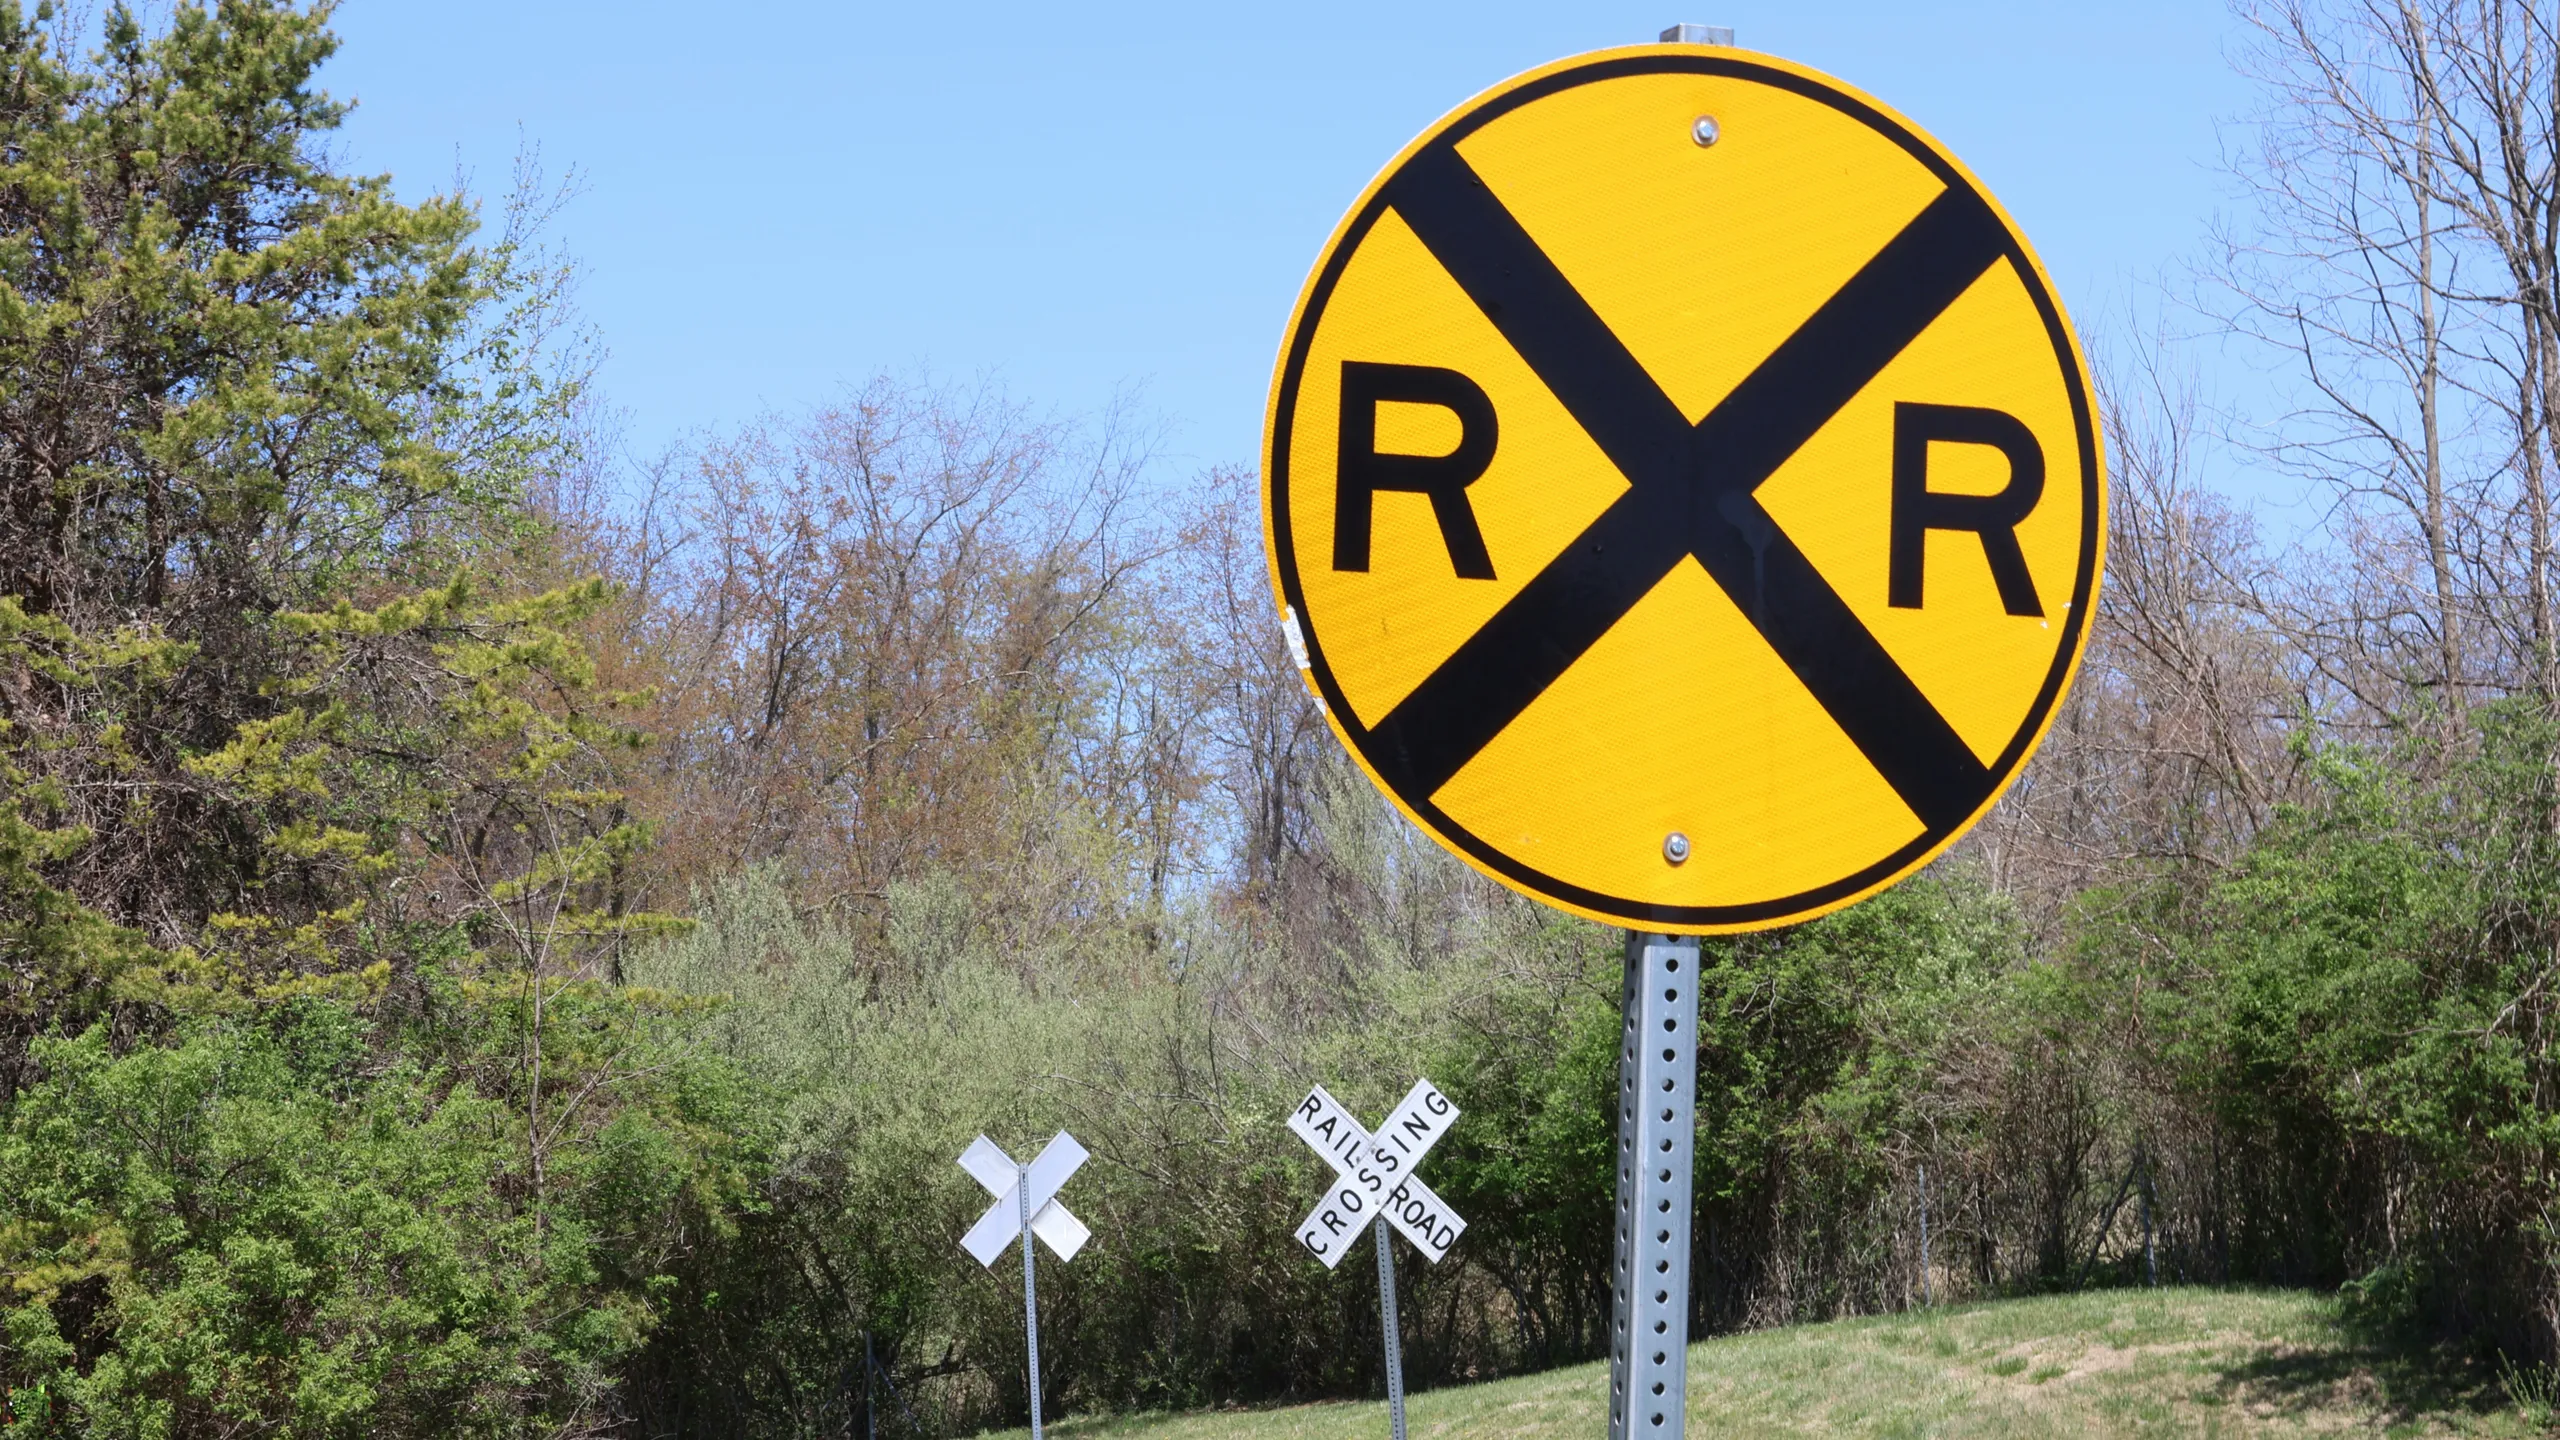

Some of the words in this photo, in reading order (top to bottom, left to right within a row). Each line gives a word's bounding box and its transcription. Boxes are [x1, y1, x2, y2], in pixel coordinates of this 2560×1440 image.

[1332, 360, 1499, 581] R
[1888, 400, 2046, 618] R
[1298, 1093, 1361, 1169] RAIL
[1304, 1091, 1449, 1255] CROSSING
[1386, 1183, 1455, 1251] ROAD
